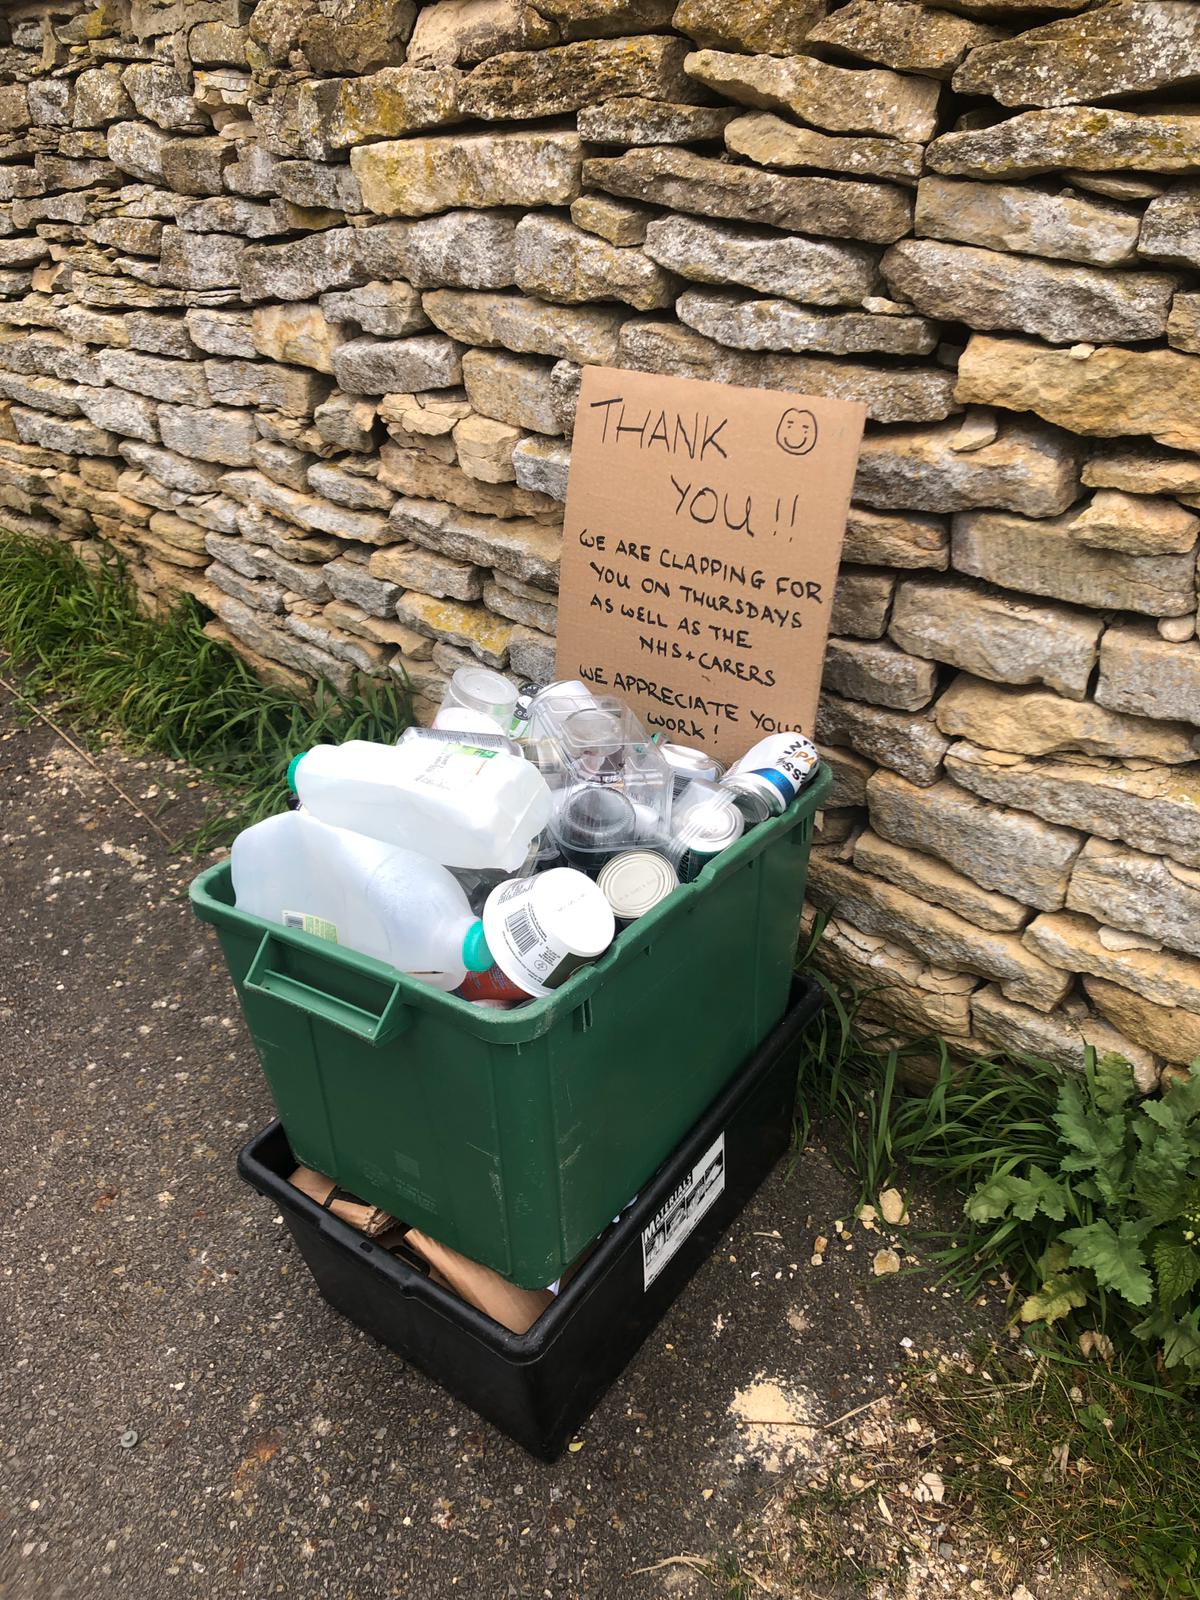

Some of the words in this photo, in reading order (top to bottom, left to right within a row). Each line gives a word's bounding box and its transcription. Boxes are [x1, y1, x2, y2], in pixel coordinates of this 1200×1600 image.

[590, 398, 728, 461] THANK
[579, 528, 606, 551] WE
[615, 539, 651, 562] ARE
[659, 549, 766, 590] CLAPPING
[776, 576, 823, 604] FOR
[589, 561, 631, 590] YOU
[641, 577, 671, 598] ON
[679, 585, 803, 629] THURSDAYS
[590, 593, 614, 613] AS
[620, 604, 669, 629] WELL
[677, 616, 701, 636] AS
[707, 624, 753, 650] THE
[579, 664, 608, 686] WE
[613, 672, 740, 723] APPRECIATE
[643, 1170, 694, 1244] MATERIALS
